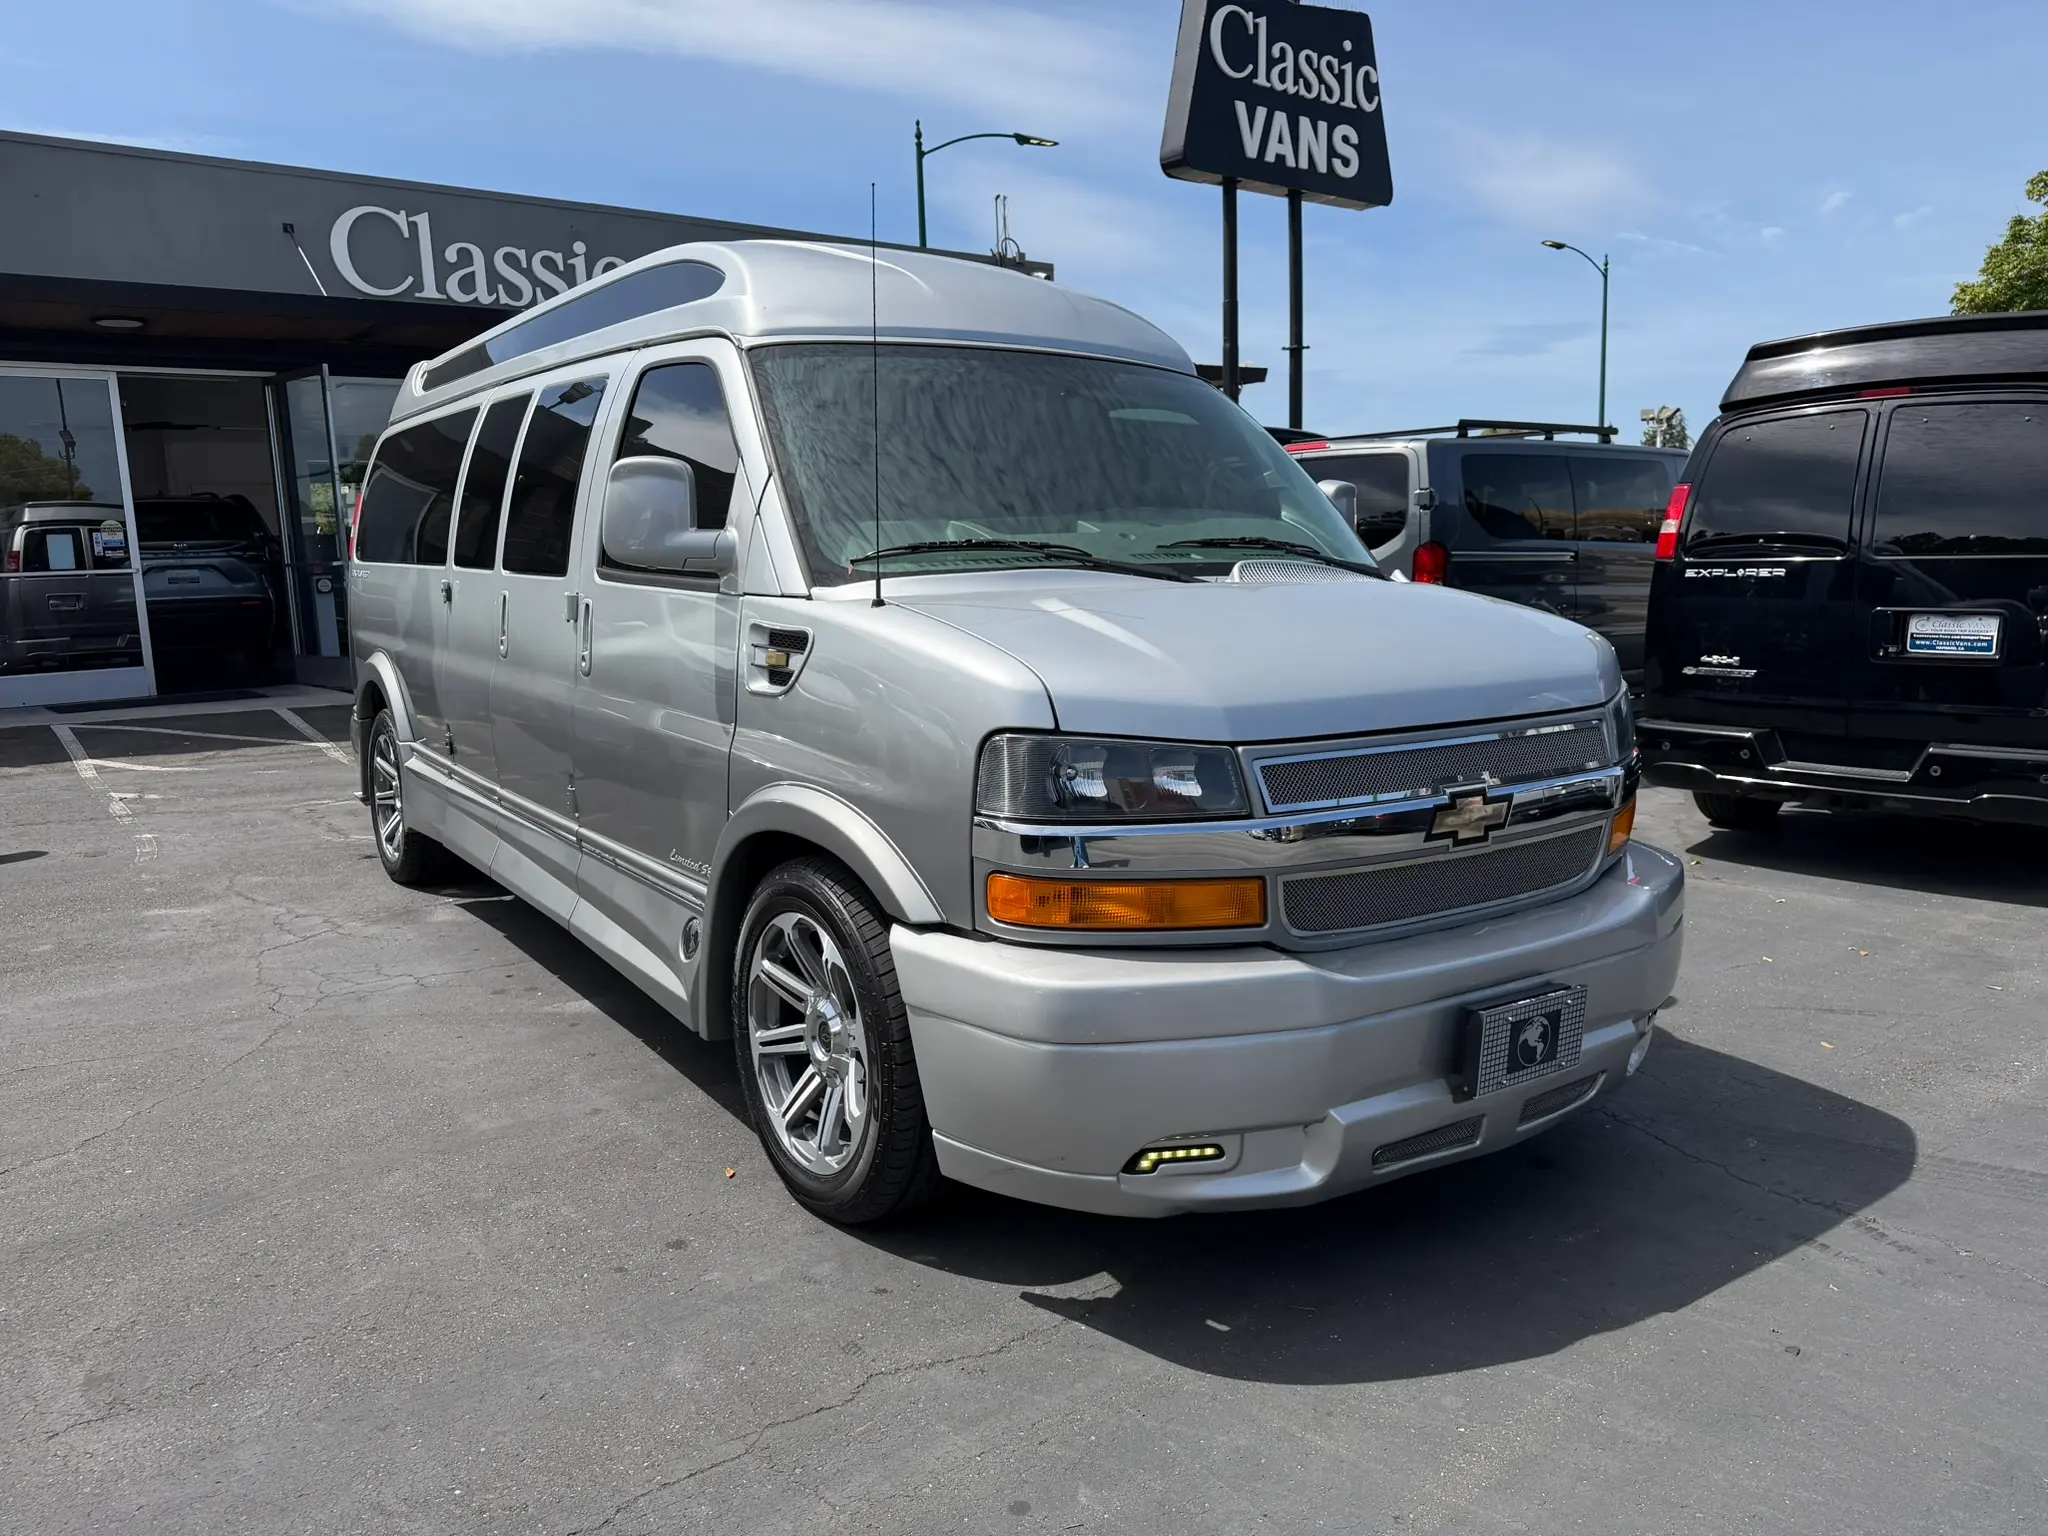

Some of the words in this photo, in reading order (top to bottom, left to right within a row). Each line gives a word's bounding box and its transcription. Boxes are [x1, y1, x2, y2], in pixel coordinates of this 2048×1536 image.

[1209, 4, 1379, 113] Classic
[1233, 99, 1360, 180] VANS
[1684, 567, 1787, 578] EXPLORER
[1932, 619, 1965, 628] Classic
[1967, 621, 1992, 630] VANS
[1916, 639, 1988, 647] www.ClassicVans.com
[669, 848, 702, 871] Limited
